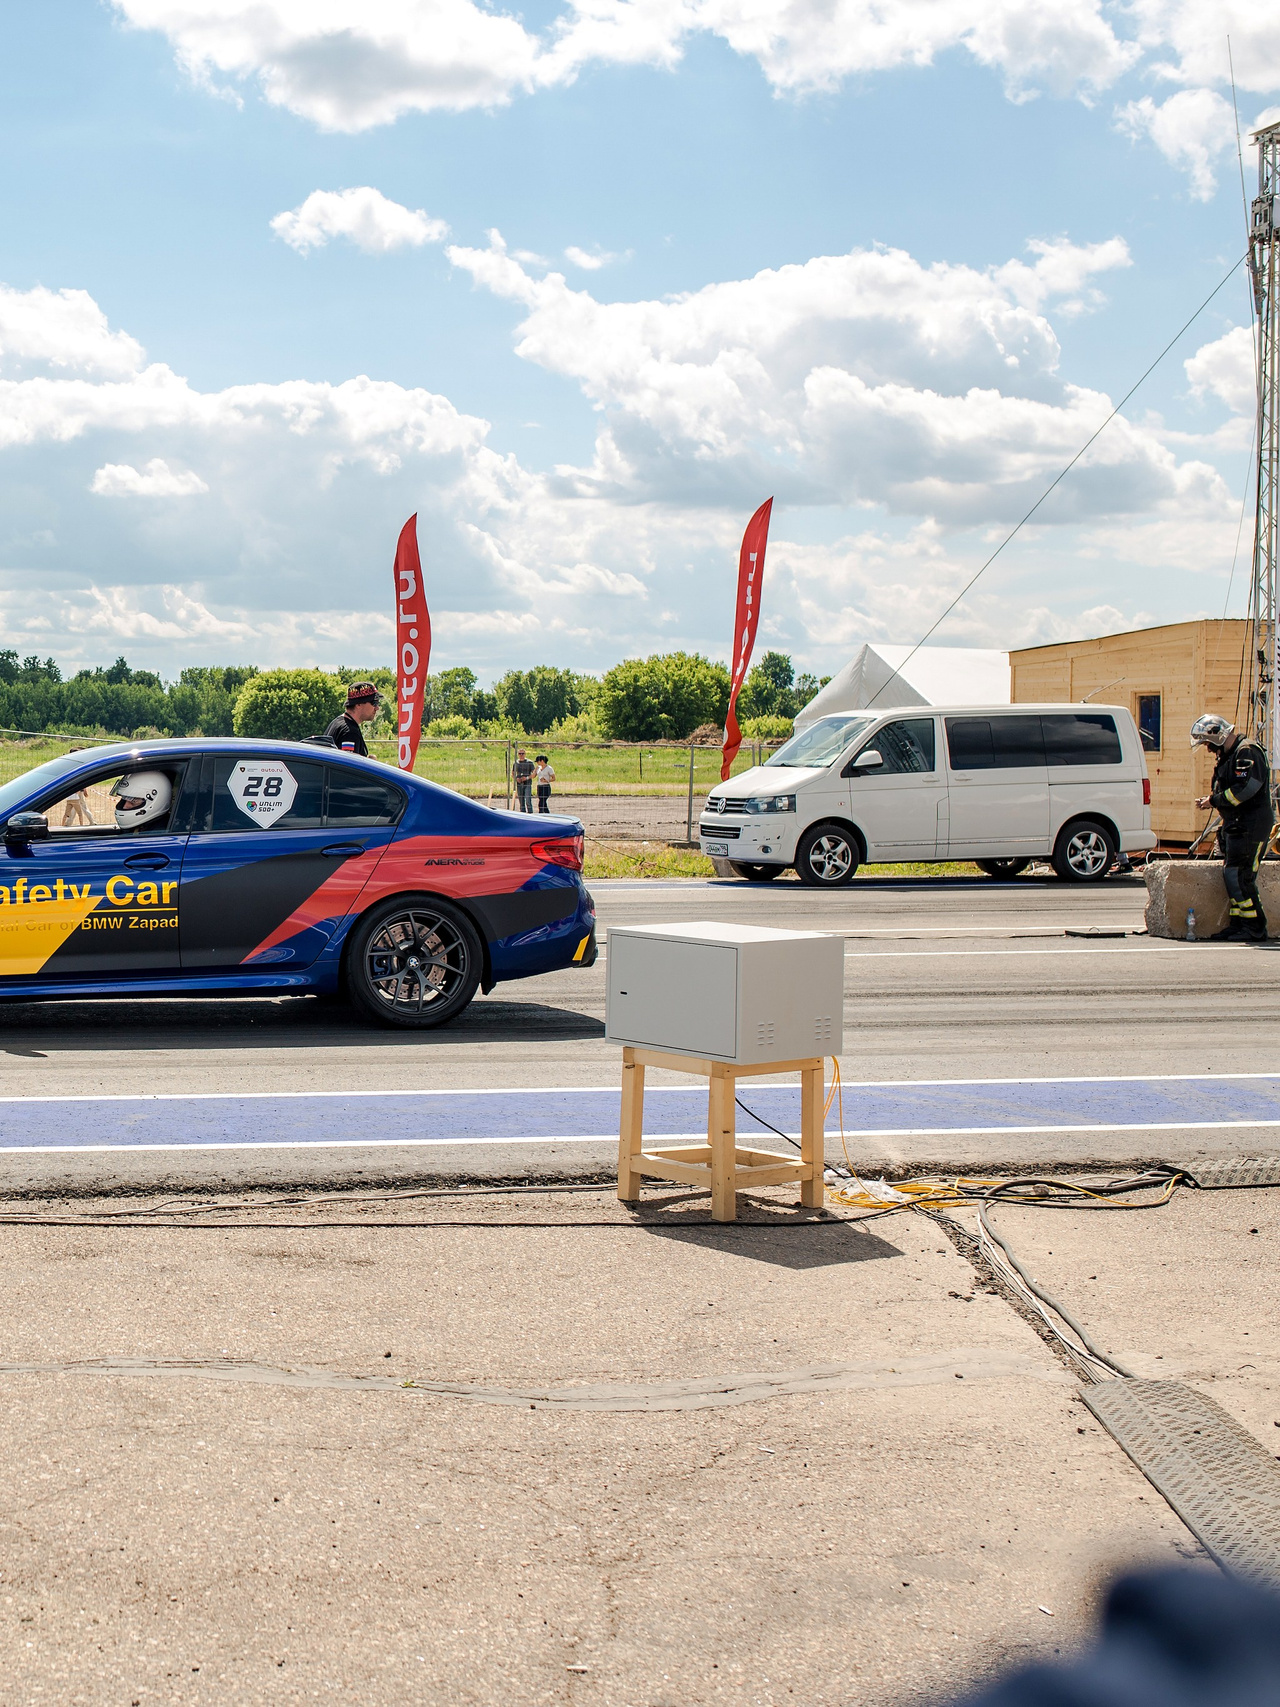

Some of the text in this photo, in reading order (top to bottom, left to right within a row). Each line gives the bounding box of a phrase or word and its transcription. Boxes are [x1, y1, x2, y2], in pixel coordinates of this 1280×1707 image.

[398, 570, 419, 768] auto.ru
[242, 776, 283, 797] 28
[105, 875, 178, 906] Car
[25, 919, 54, 932] Car
[81, 917, 123, 930] BMW
[128, 915, 178, 931] Zapad
